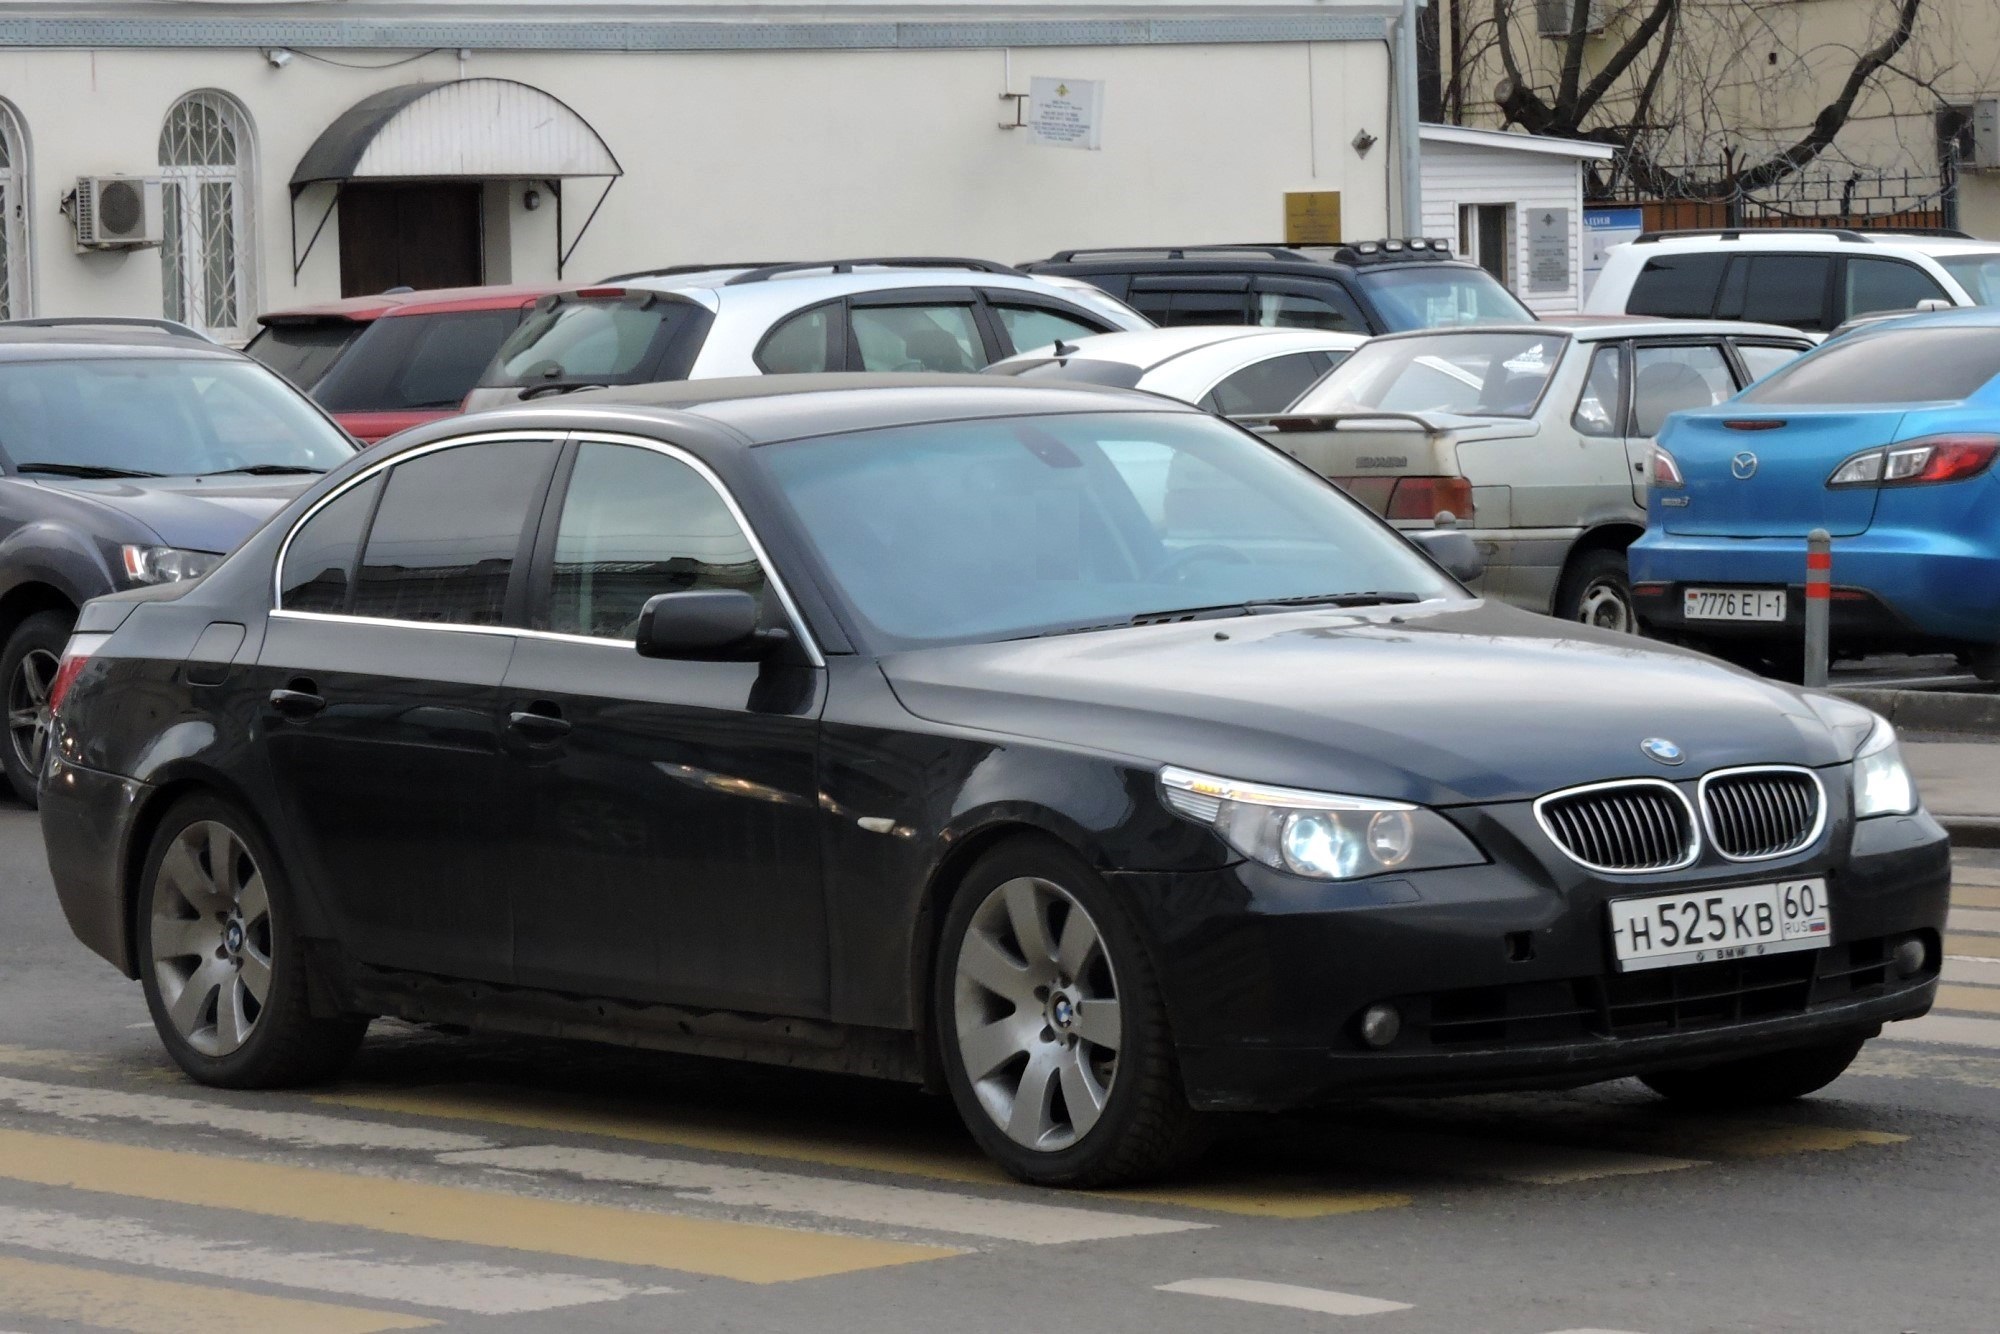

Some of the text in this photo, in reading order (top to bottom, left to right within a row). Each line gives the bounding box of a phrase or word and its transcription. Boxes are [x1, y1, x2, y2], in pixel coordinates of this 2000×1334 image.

[1699, 592, 1781, 617] 7776 EI-1
[1784, 884, 1815, 919] 60
[1784, 919, 1809, 934] RUS
[1716, 946, 1747, 960] BMW
